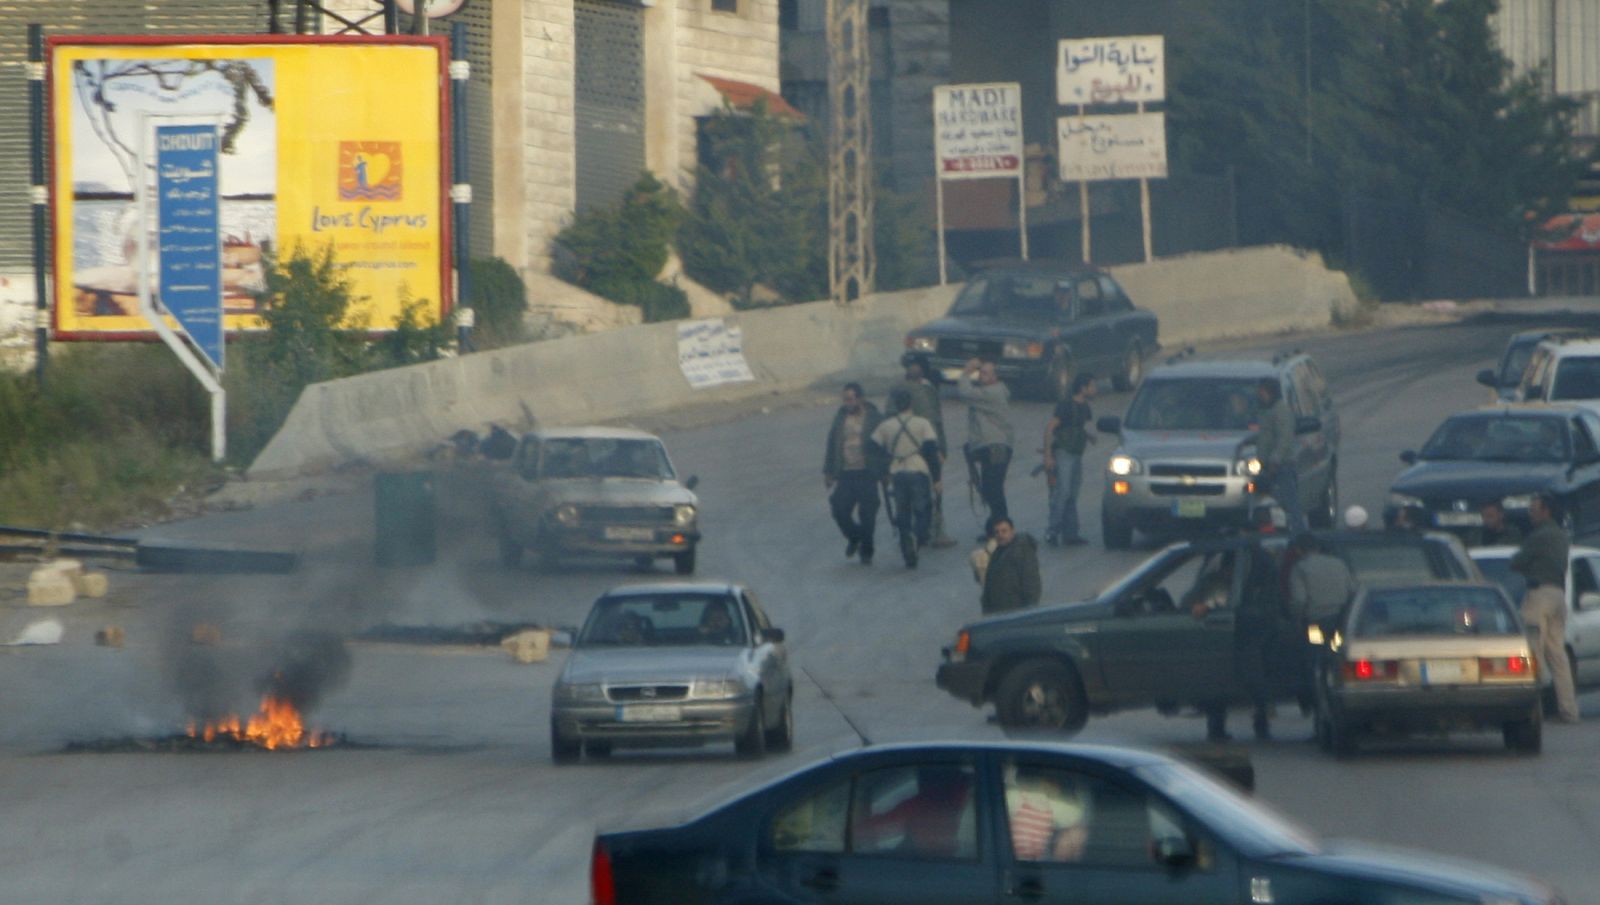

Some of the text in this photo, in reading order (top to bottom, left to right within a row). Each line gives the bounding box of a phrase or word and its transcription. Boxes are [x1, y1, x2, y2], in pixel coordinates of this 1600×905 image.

[1106, 41, 1158, 75] بناية
[949, 88, 1006, 108] MADI
[312, 205, 428, 234] Love Cyprus
